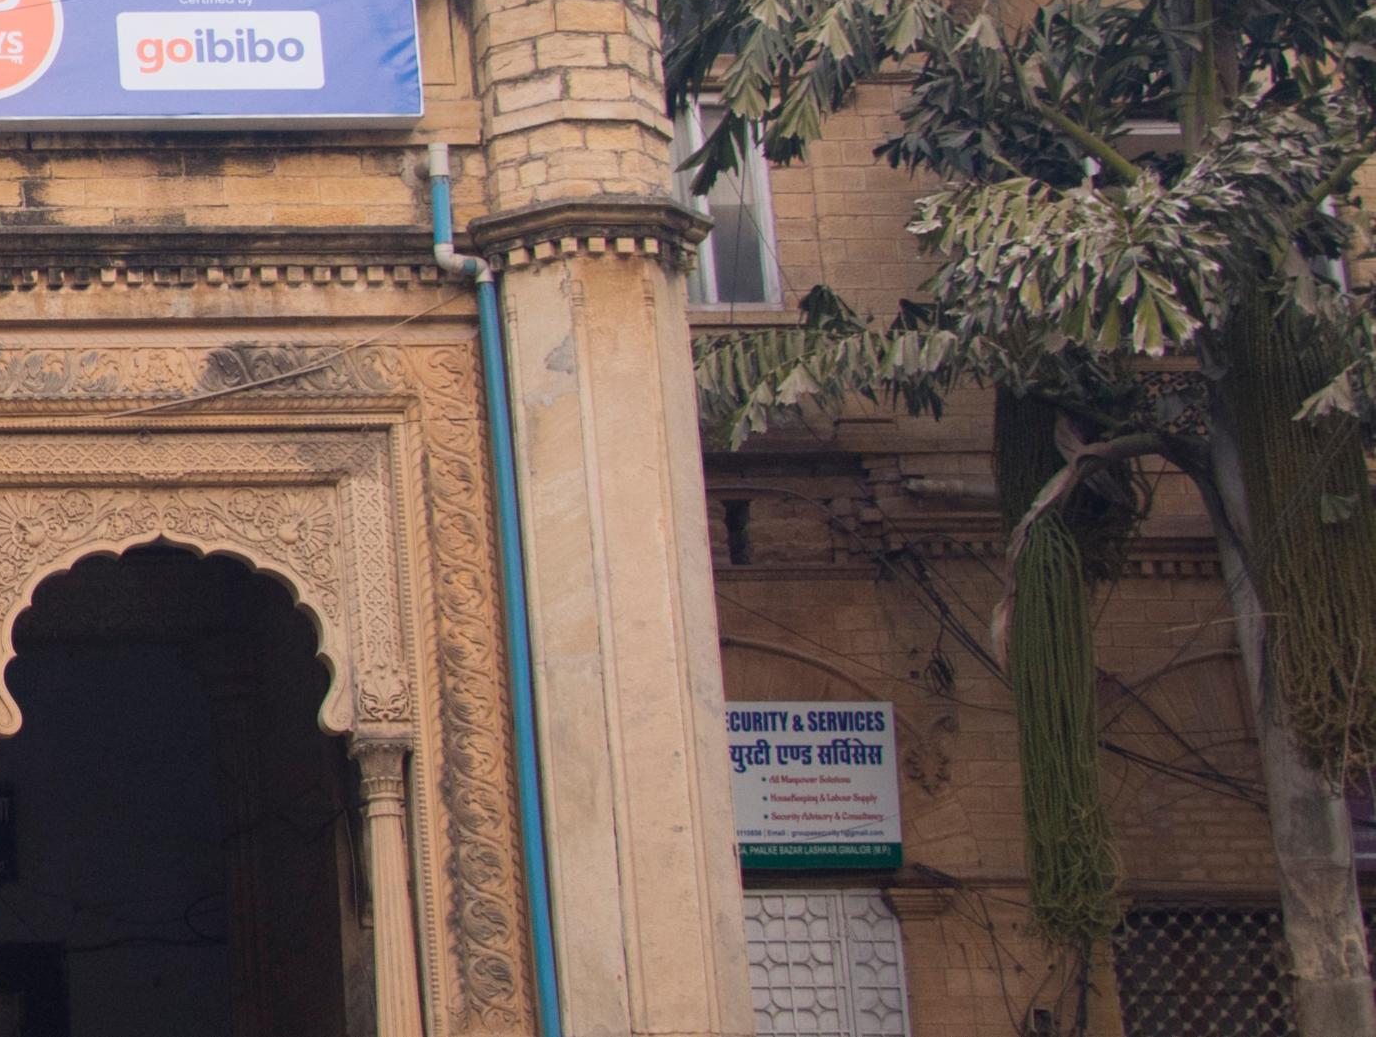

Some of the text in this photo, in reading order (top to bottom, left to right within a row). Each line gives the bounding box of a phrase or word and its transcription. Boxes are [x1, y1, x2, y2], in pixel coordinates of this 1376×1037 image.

[136, 28, 305, 74] goibibo
[792, 714, 804, 732] &
[807, 711, 885, 732] SERVICES
[775, 744, 813, 765] एण्ड
[817, 738, 883, 765] सर्विसेस
[771, 813, 800, 822] Security
